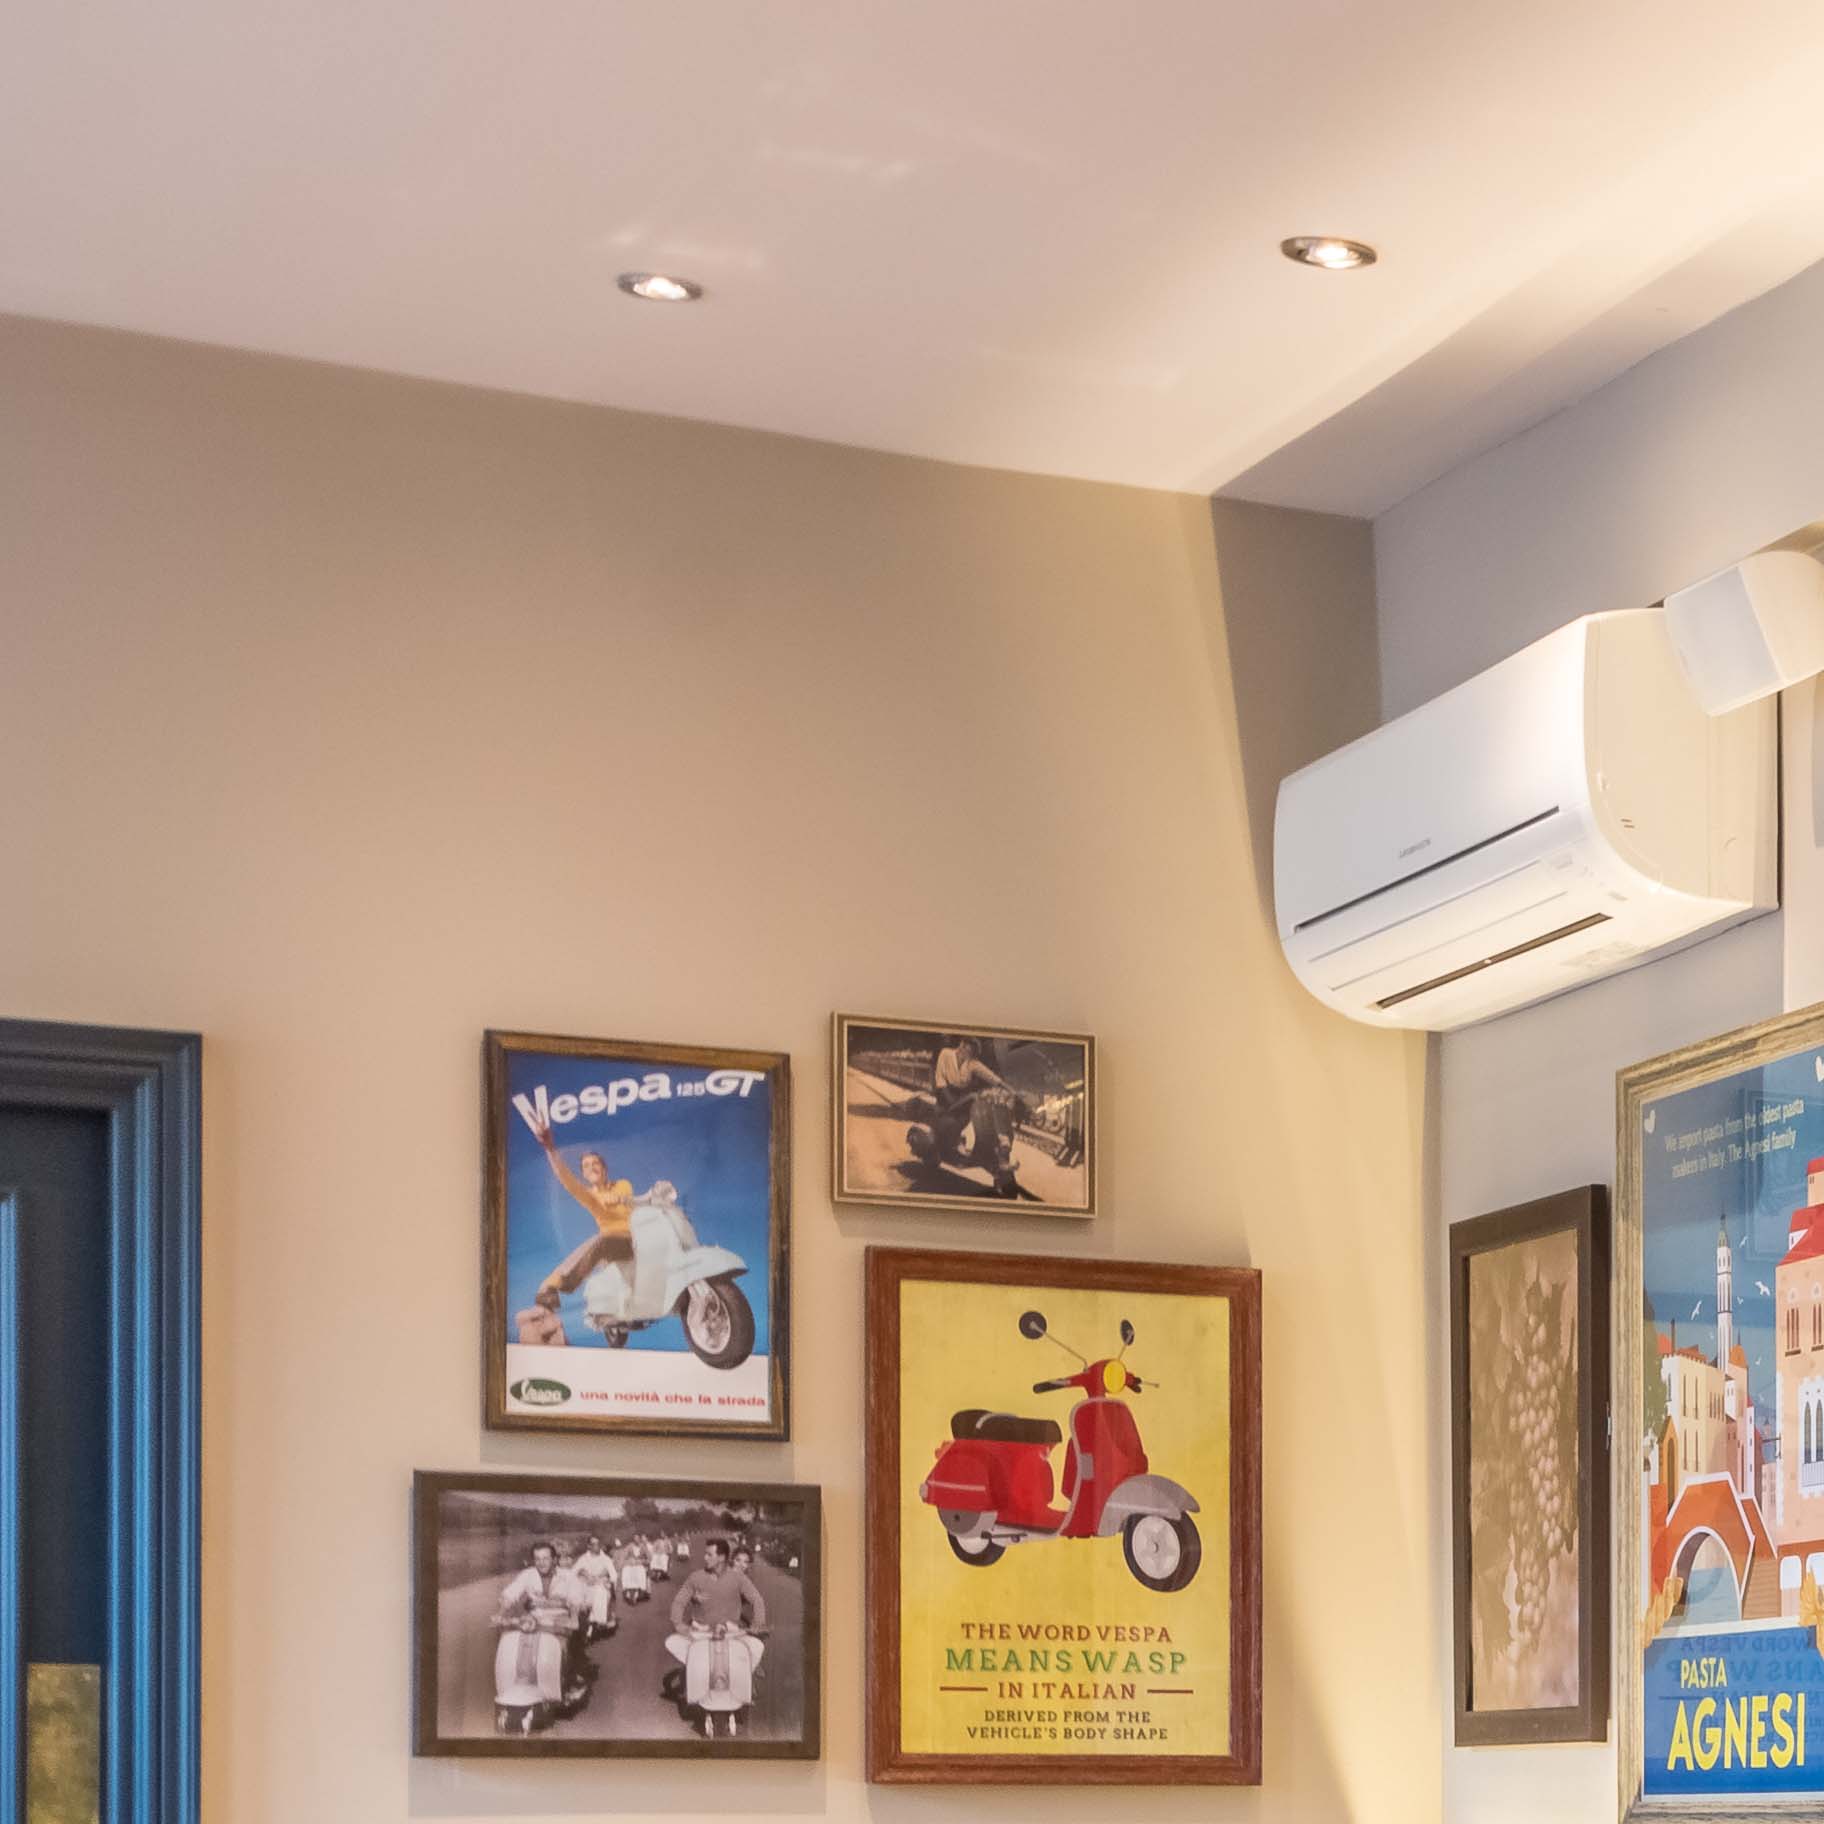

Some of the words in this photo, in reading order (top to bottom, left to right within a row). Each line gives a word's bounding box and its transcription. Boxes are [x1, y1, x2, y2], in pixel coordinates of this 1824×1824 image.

[512, 1072, 672, 1137] Vespa
[676, 1081, 705, 1097] 125
[705, 1069, 765, 1097] GT
[1664, 1133, 1677, 1152] We
[1703, 1123, 1724, 1146] pasta
[1725, 1116, 1744, 1135] from
[1744, 1111, 1756, 1129] the
[1782, 1098, 1805, 1123] pasta
[1728, 1143, 1743, 1161] The
[1771, 1126, 1797, 1150] family
[580, 1391, 608, 1401] una
[614, 1390, 660, 1404] novità
[664, 1393, 693, 1405] che
[698, 1393, 712, 1405] la
[717, 1396, 765, 1407] strada
[961, 1623, 1011, 1640] THE
[1016, 1624, 1090, 1642] WORD
[1096, 1625, 1172, 1643] VESPA
[945, 1648, 1073, 1673] MEANS
[1081, 1651, 1187, 1674] WASP
[1680, 1657, 1728, 1689] PASTA
[998, 1682, 1023, 1699] IN
[1032, 1683, 1136, 1700] ITALIAN
[984, 1710, 1057, 1723] DERIVED
[1063, 1710, 1110, 1723] FROM
[1115, 1711, 1151, 1724] THE
[967, 1726, 1057, 1739] VEHICLE'S
[1063, 1727, 1107, 1740] BODY
[1113, 1727, 1168, 1740] SHAPE
[1667, 1692, 1805, 1771] AGNESI
